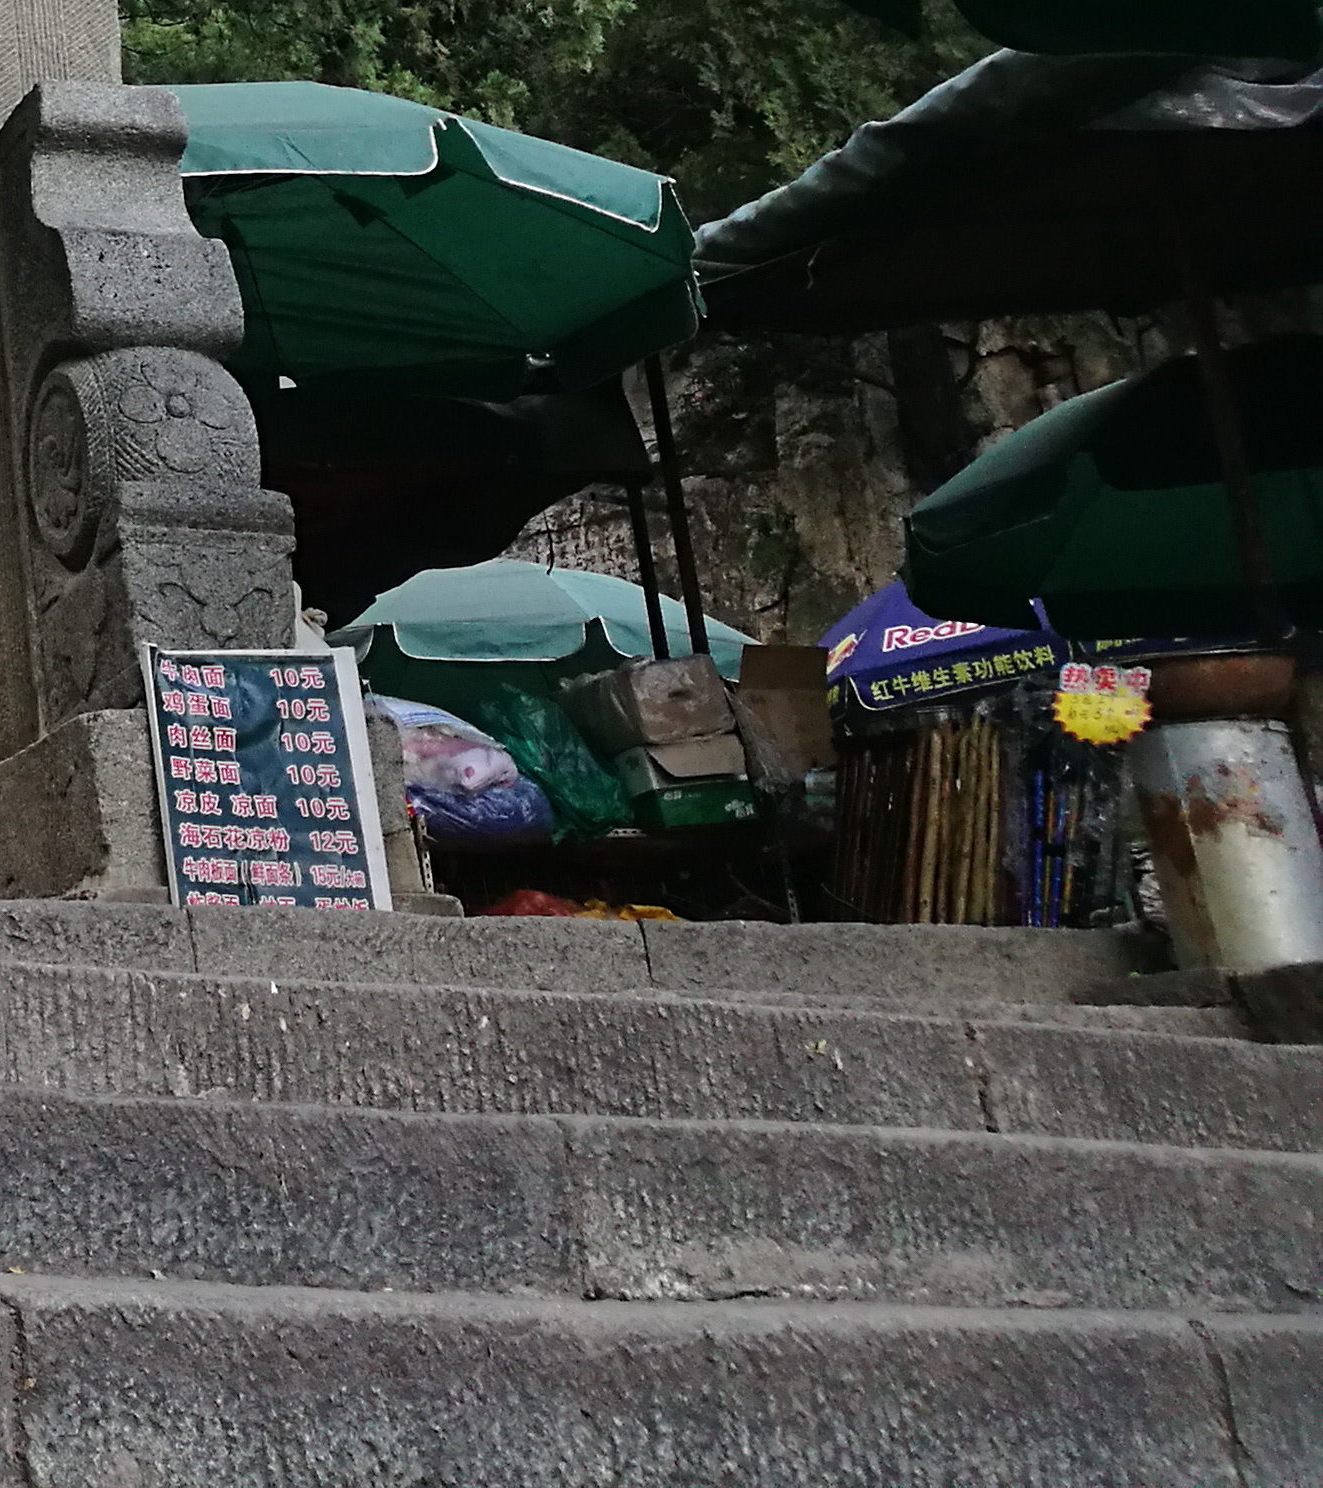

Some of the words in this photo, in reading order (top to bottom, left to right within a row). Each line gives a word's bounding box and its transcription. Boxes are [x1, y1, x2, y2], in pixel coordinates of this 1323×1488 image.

[160, 658, 225, 688] 牛肉面
[270, 667, 325, 689] 10元
[870, 644, 1055, 702] 红牛维生素功能饮料
[162, 691, 232, 720] 鸡蛋面
[276, 698, 330, 722] 10元
[167, 723, 236, 752] 肉丝面
[281, 731, 336, 754] 10元
[170, 756, 241, 785] 野菜面
[287, 764, 341, 788] 10元
[174, 789, 222, 816] 凉皮
[230, 794, 278, 819] 凉面
[296, 797, 351, 821] 10元
[179, 822, 290, 853] 海石花凉粉
[309, 831, 359, 854] 12元
